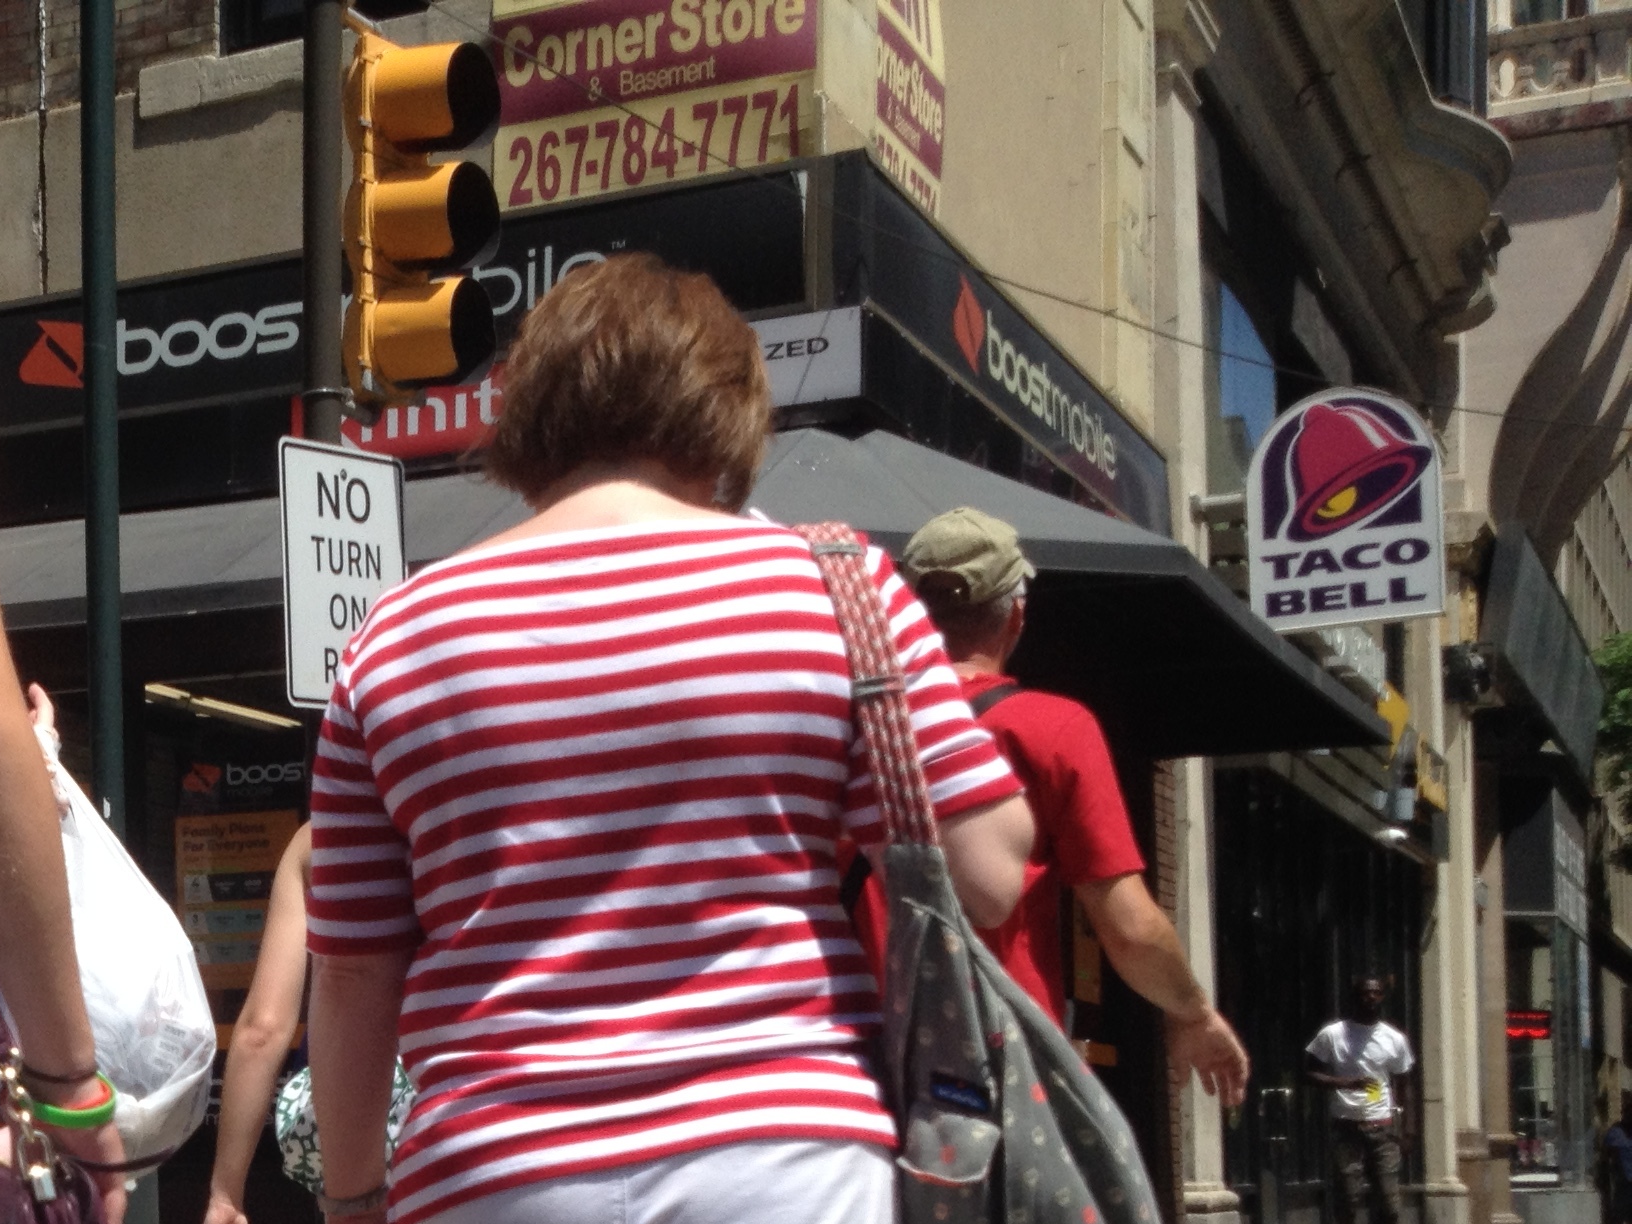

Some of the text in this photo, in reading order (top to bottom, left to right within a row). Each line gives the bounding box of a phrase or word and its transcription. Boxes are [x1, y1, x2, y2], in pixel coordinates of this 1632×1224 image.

[504, 0, 806, 88] Corner Store
[589, 56, 716, 101] & Basement
[508, 85, 800, 207] 267-784-7771
[116, 301, 303, 376] boos
[317, 471, 371, 524] NO
[310, 535, 382, 581] TURN
[1260, 538, 1431, 580] TACO
[329, 593, 367, 631] ON
[1266, 576, 1427, 618] BELL
